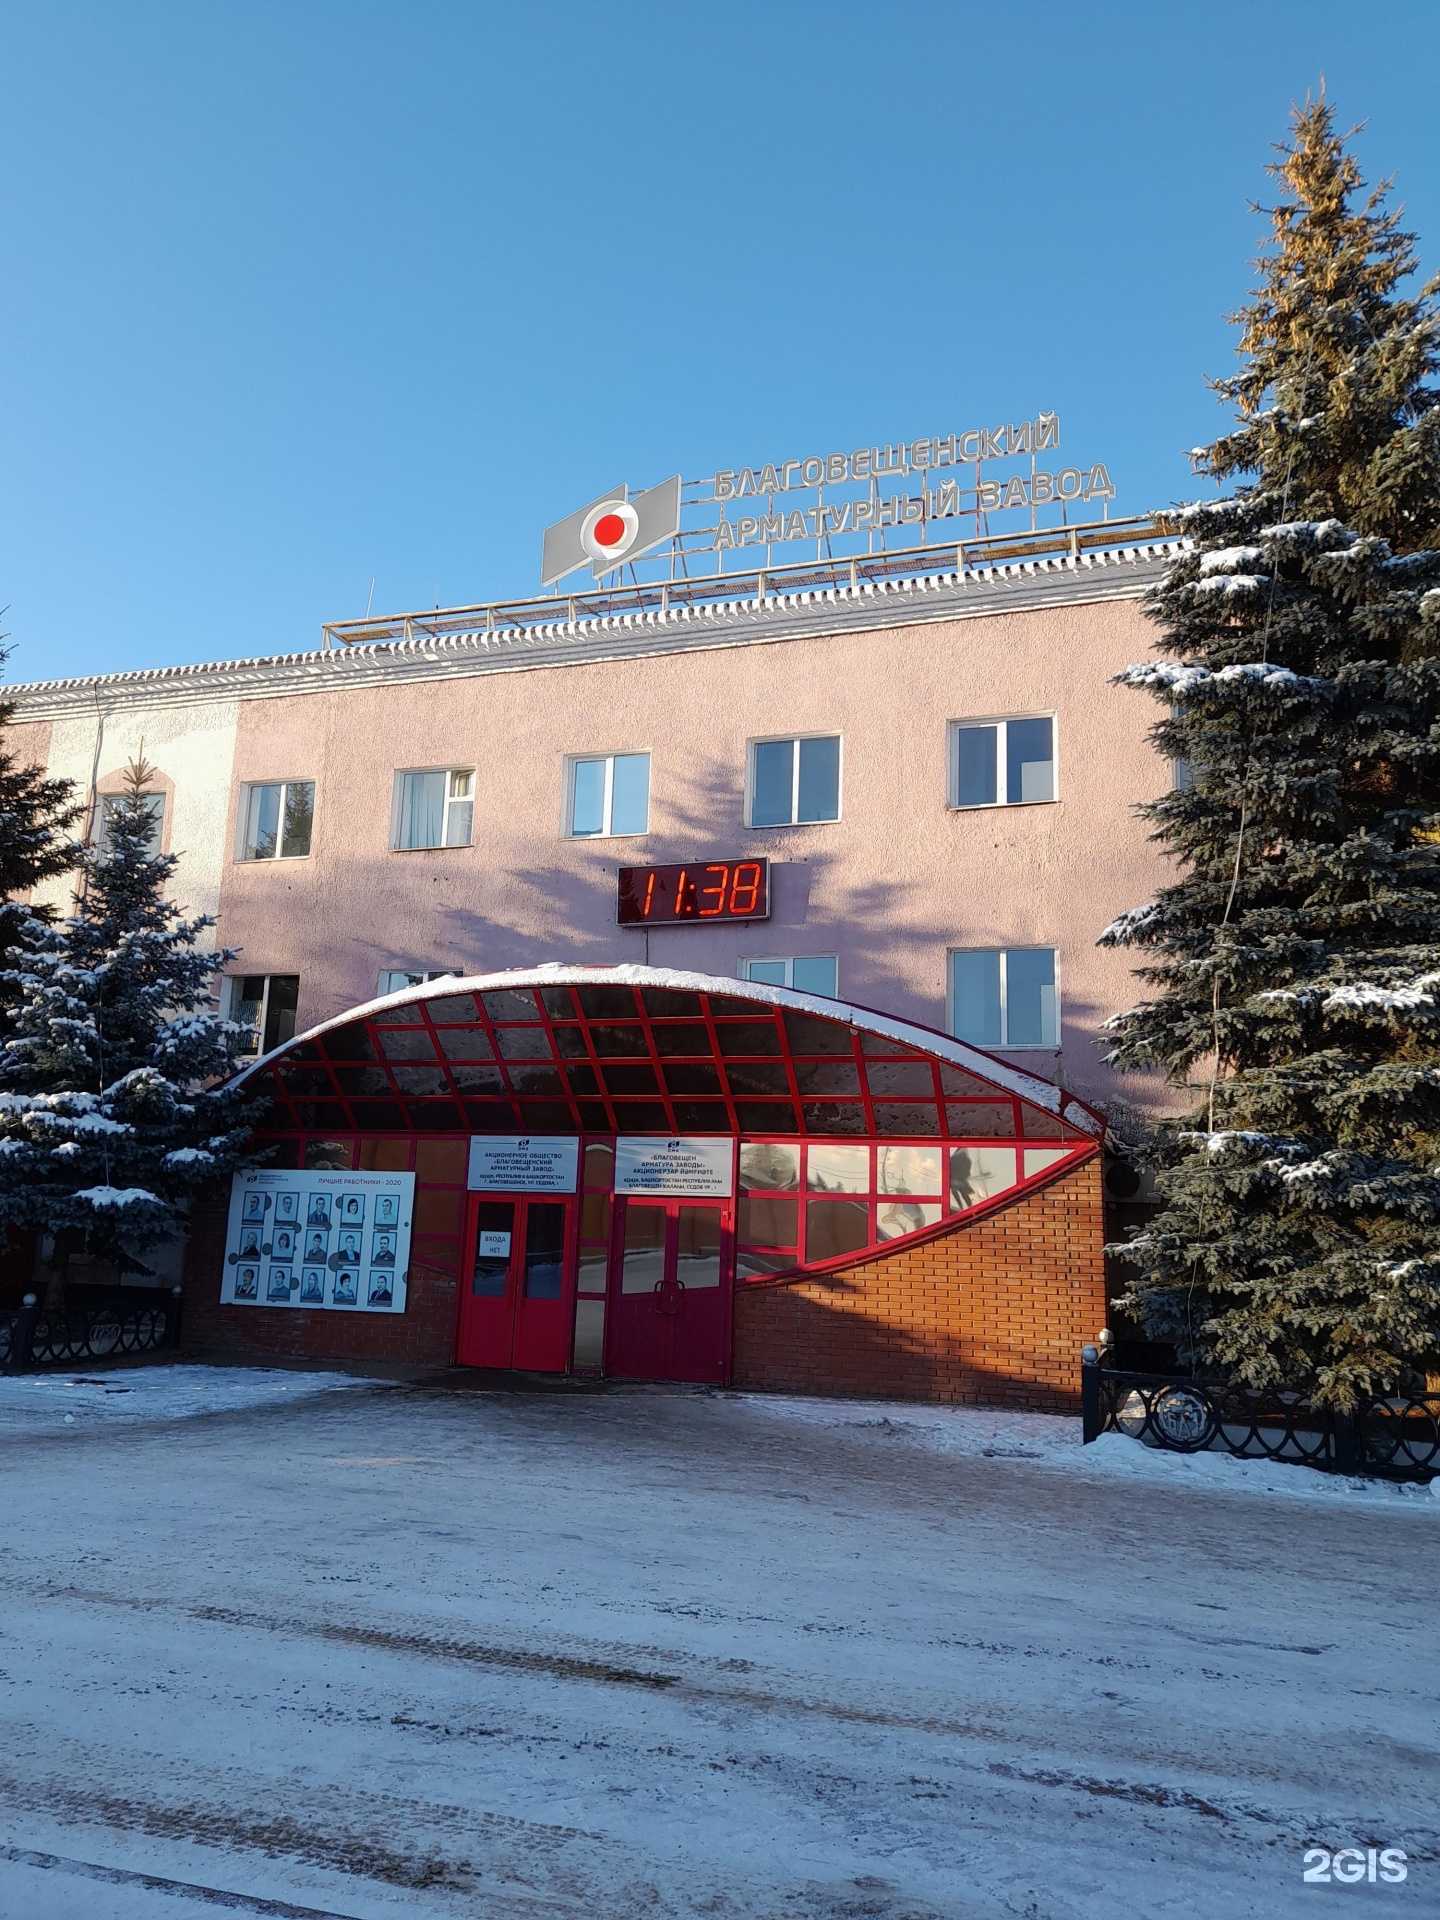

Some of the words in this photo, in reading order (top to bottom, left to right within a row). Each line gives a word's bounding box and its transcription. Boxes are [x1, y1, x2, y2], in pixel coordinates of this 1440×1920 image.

[714, 410, 1060, 501] БЛАГОВЕЩЕНСКИЙ
[713, 478, 960, 551] АРМАТУРНЫЙ
[979, 462, 1117, 513] ЗАВОД
[643, 863, 762, 917] 11:38
